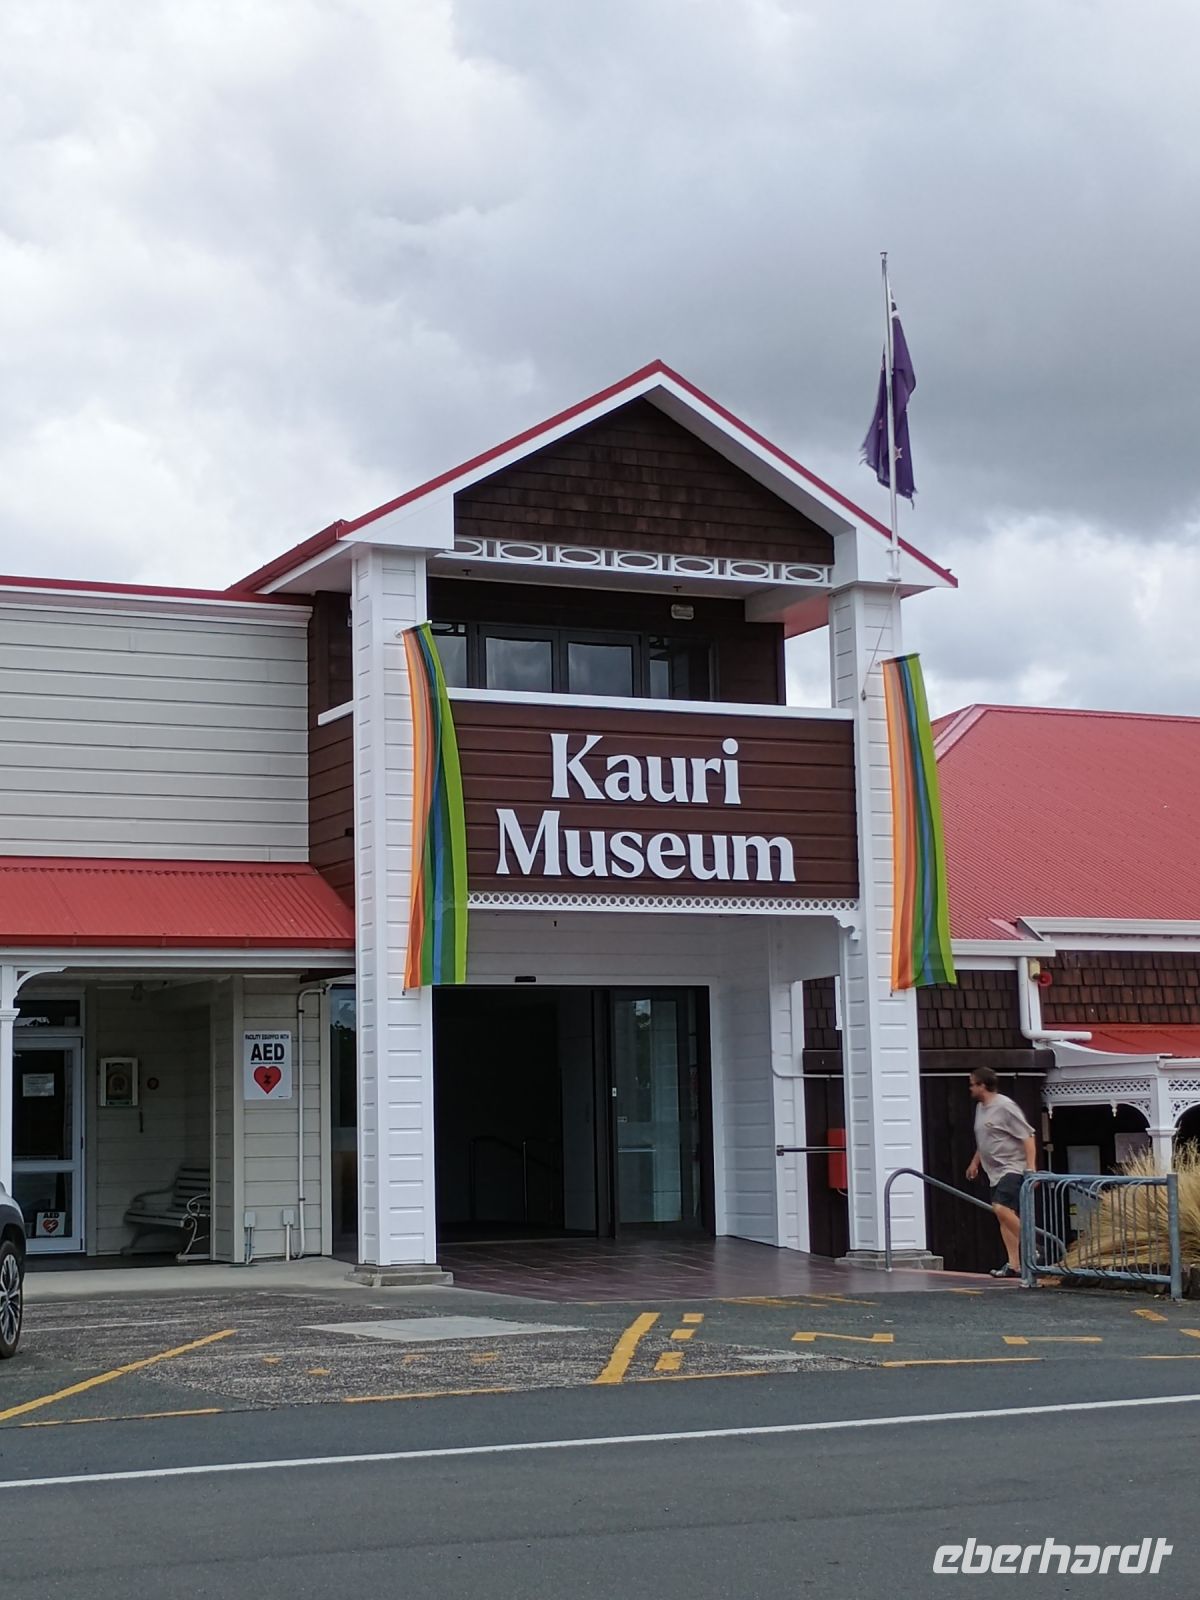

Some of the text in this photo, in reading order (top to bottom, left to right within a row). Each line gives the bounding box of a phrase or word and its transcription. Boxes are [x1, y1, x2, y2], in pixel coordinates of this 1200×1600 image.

[550, 733, 742, 805] Kauri
[496, 808, 796, 882] Museum
[250, 1043, 285, 1061] AED
